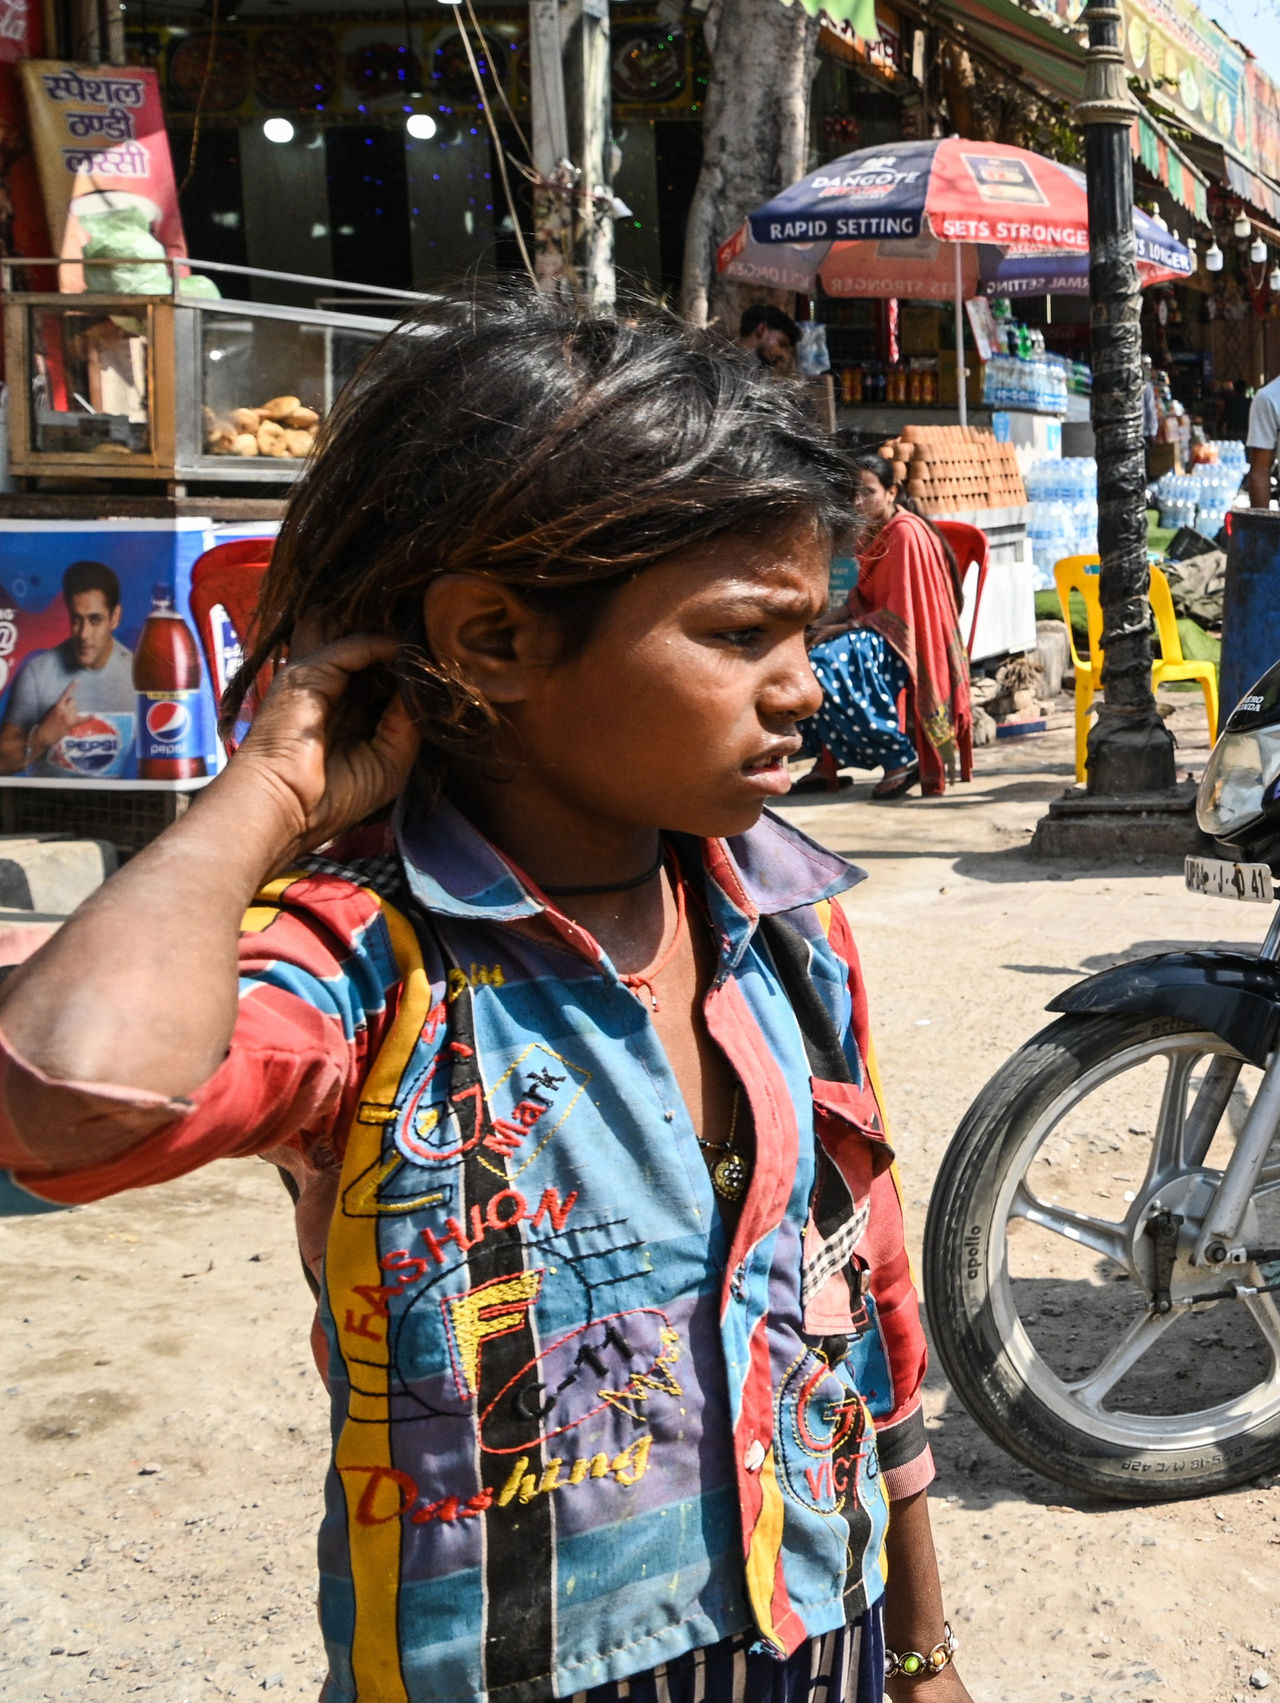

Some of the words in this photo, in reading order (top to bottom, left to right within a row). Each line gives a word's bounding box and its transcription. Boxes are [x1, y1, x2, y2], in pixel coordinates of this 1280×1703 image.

[42, 68, 146, 107] स्पेशल
[66, 105, 134, 141] ठण्डी
[62, 141, 149, 177] लस्सी
[811, 171, 920, 189] DANGOTE
[770, 220, 828, 239] RAPID
[836, 217, 913, 235] SETTING
[943, 220, 990, 238] SETS
[996, 222, 1088, 246] STRONGE
[64, 739, 118, 751] PEPSI
[150, 743, 187, 755] pepsi
[482, 1066, 567, 1158] Mark
[344, 1187, 578, 1342] FASHION
[964, 1225, 983, 1280] apollo
[441, 1268, 545, 1400] F
[336, 1436, 652, 1526] Dashing
